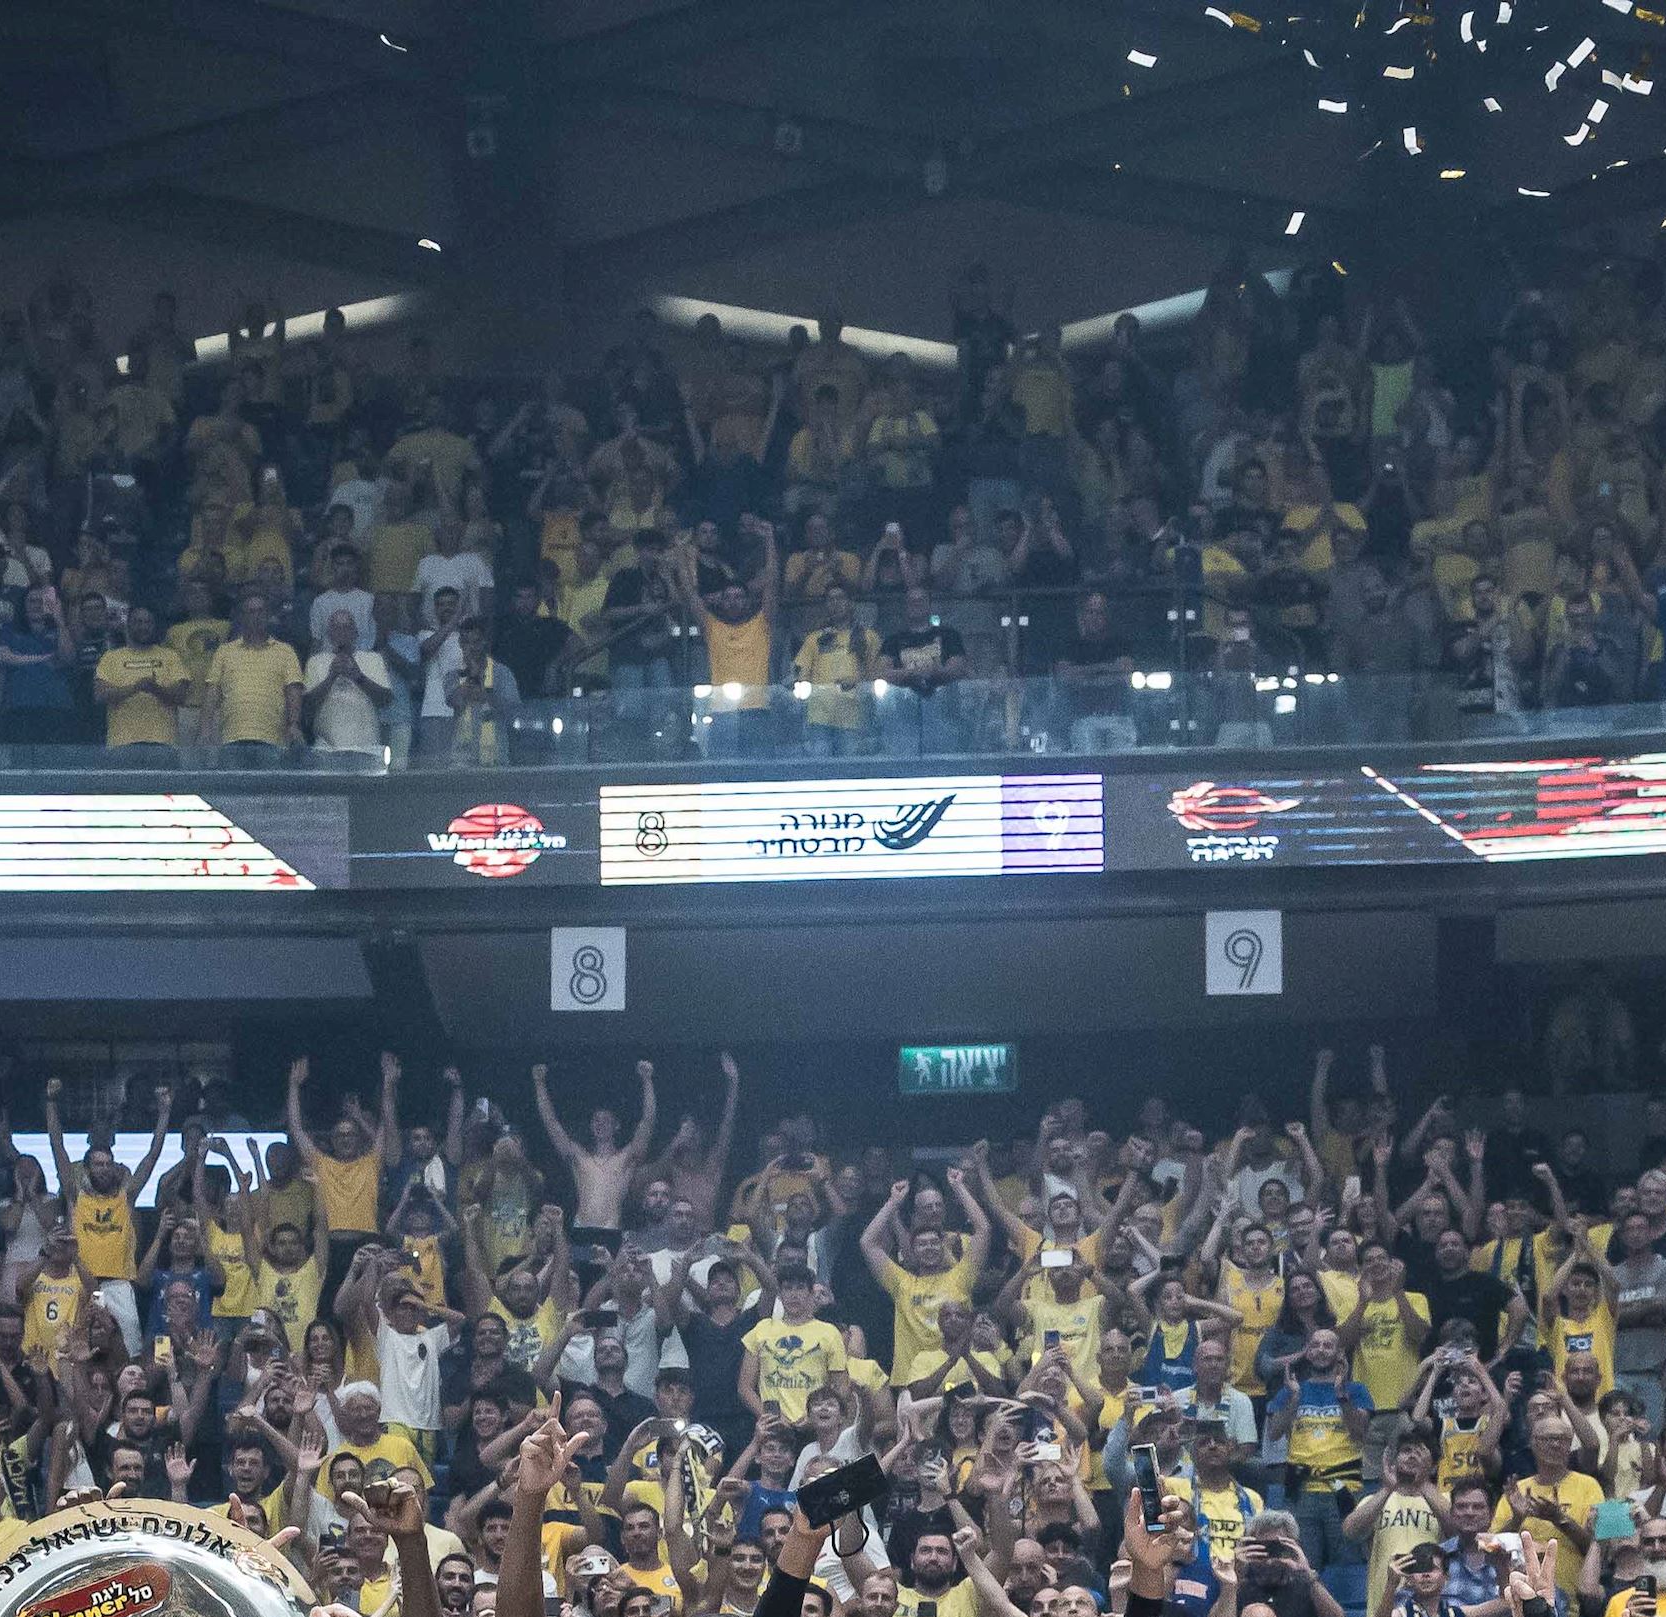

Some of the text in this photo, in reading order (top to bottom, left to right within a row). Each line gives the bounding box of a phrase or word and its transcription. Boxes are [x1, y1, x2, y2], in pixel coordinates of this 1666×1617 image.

[636, 811, 669, 857] 8
[780, 813, 865, 831] מנורה
[1224, 928, 1263, 990] 9
[570, 945, 607, 1004] 8
[46, 1301, 59, 1321] 6
[1379, 1509, 1438, 1532] GANT
[31, 1515, 134, 1556] ישראל
[91, 1579, 125, 1604] ליגת
[129, 1583, 153, 1605] סל
